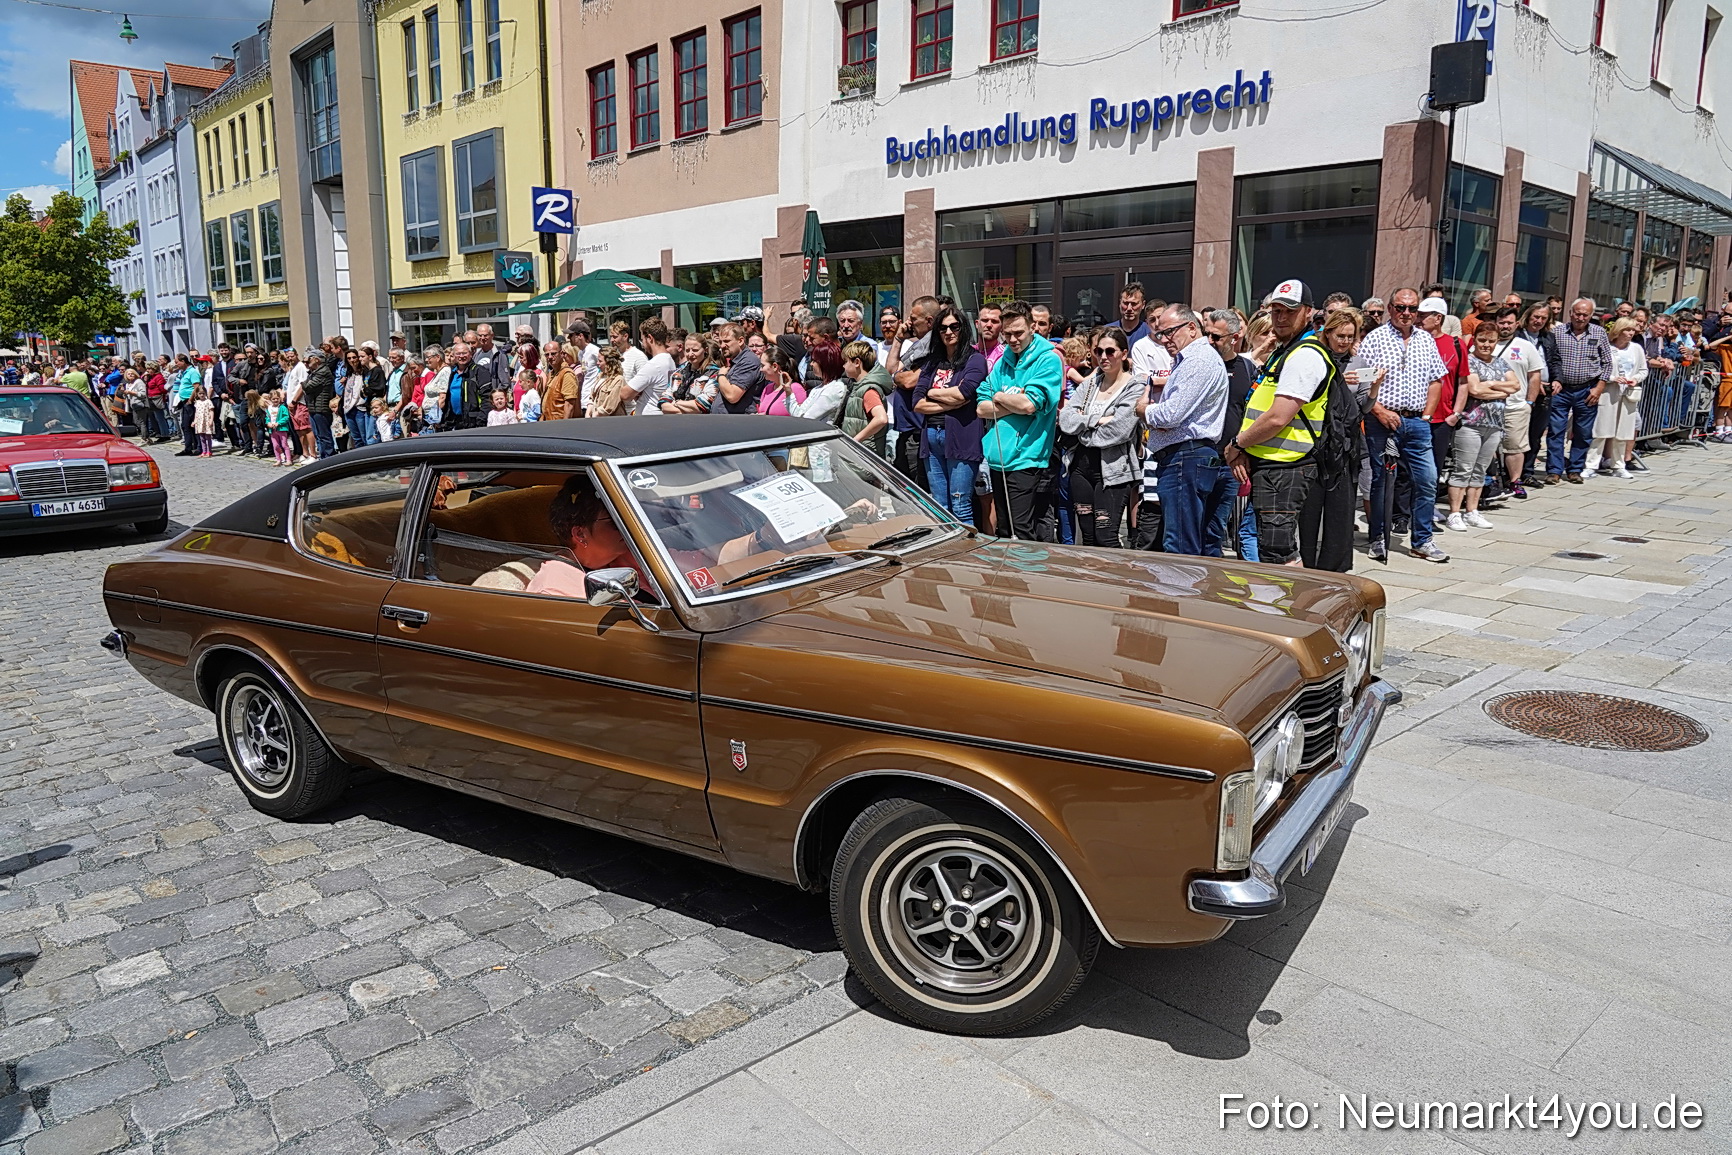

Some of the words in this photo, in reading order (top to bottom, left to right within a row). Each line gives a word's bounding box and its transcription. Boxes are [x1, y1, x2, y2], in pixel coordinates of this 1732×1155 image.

[886, 112, 1077, 165] Buchhandlung
[1090, 69, 1274, 134] Rupprecht
[591, 244, 603, 253] Markt
[603, 243, 609, 251] 15
[511, 262, 525, 279] G2
[196, 302, 206, 311] G2
[776, 481, 805, 496] 580
[40, 504, 55, 515] NM
[63, 502, 75, 513] AT
[78, 500, 104, 511] 463H
